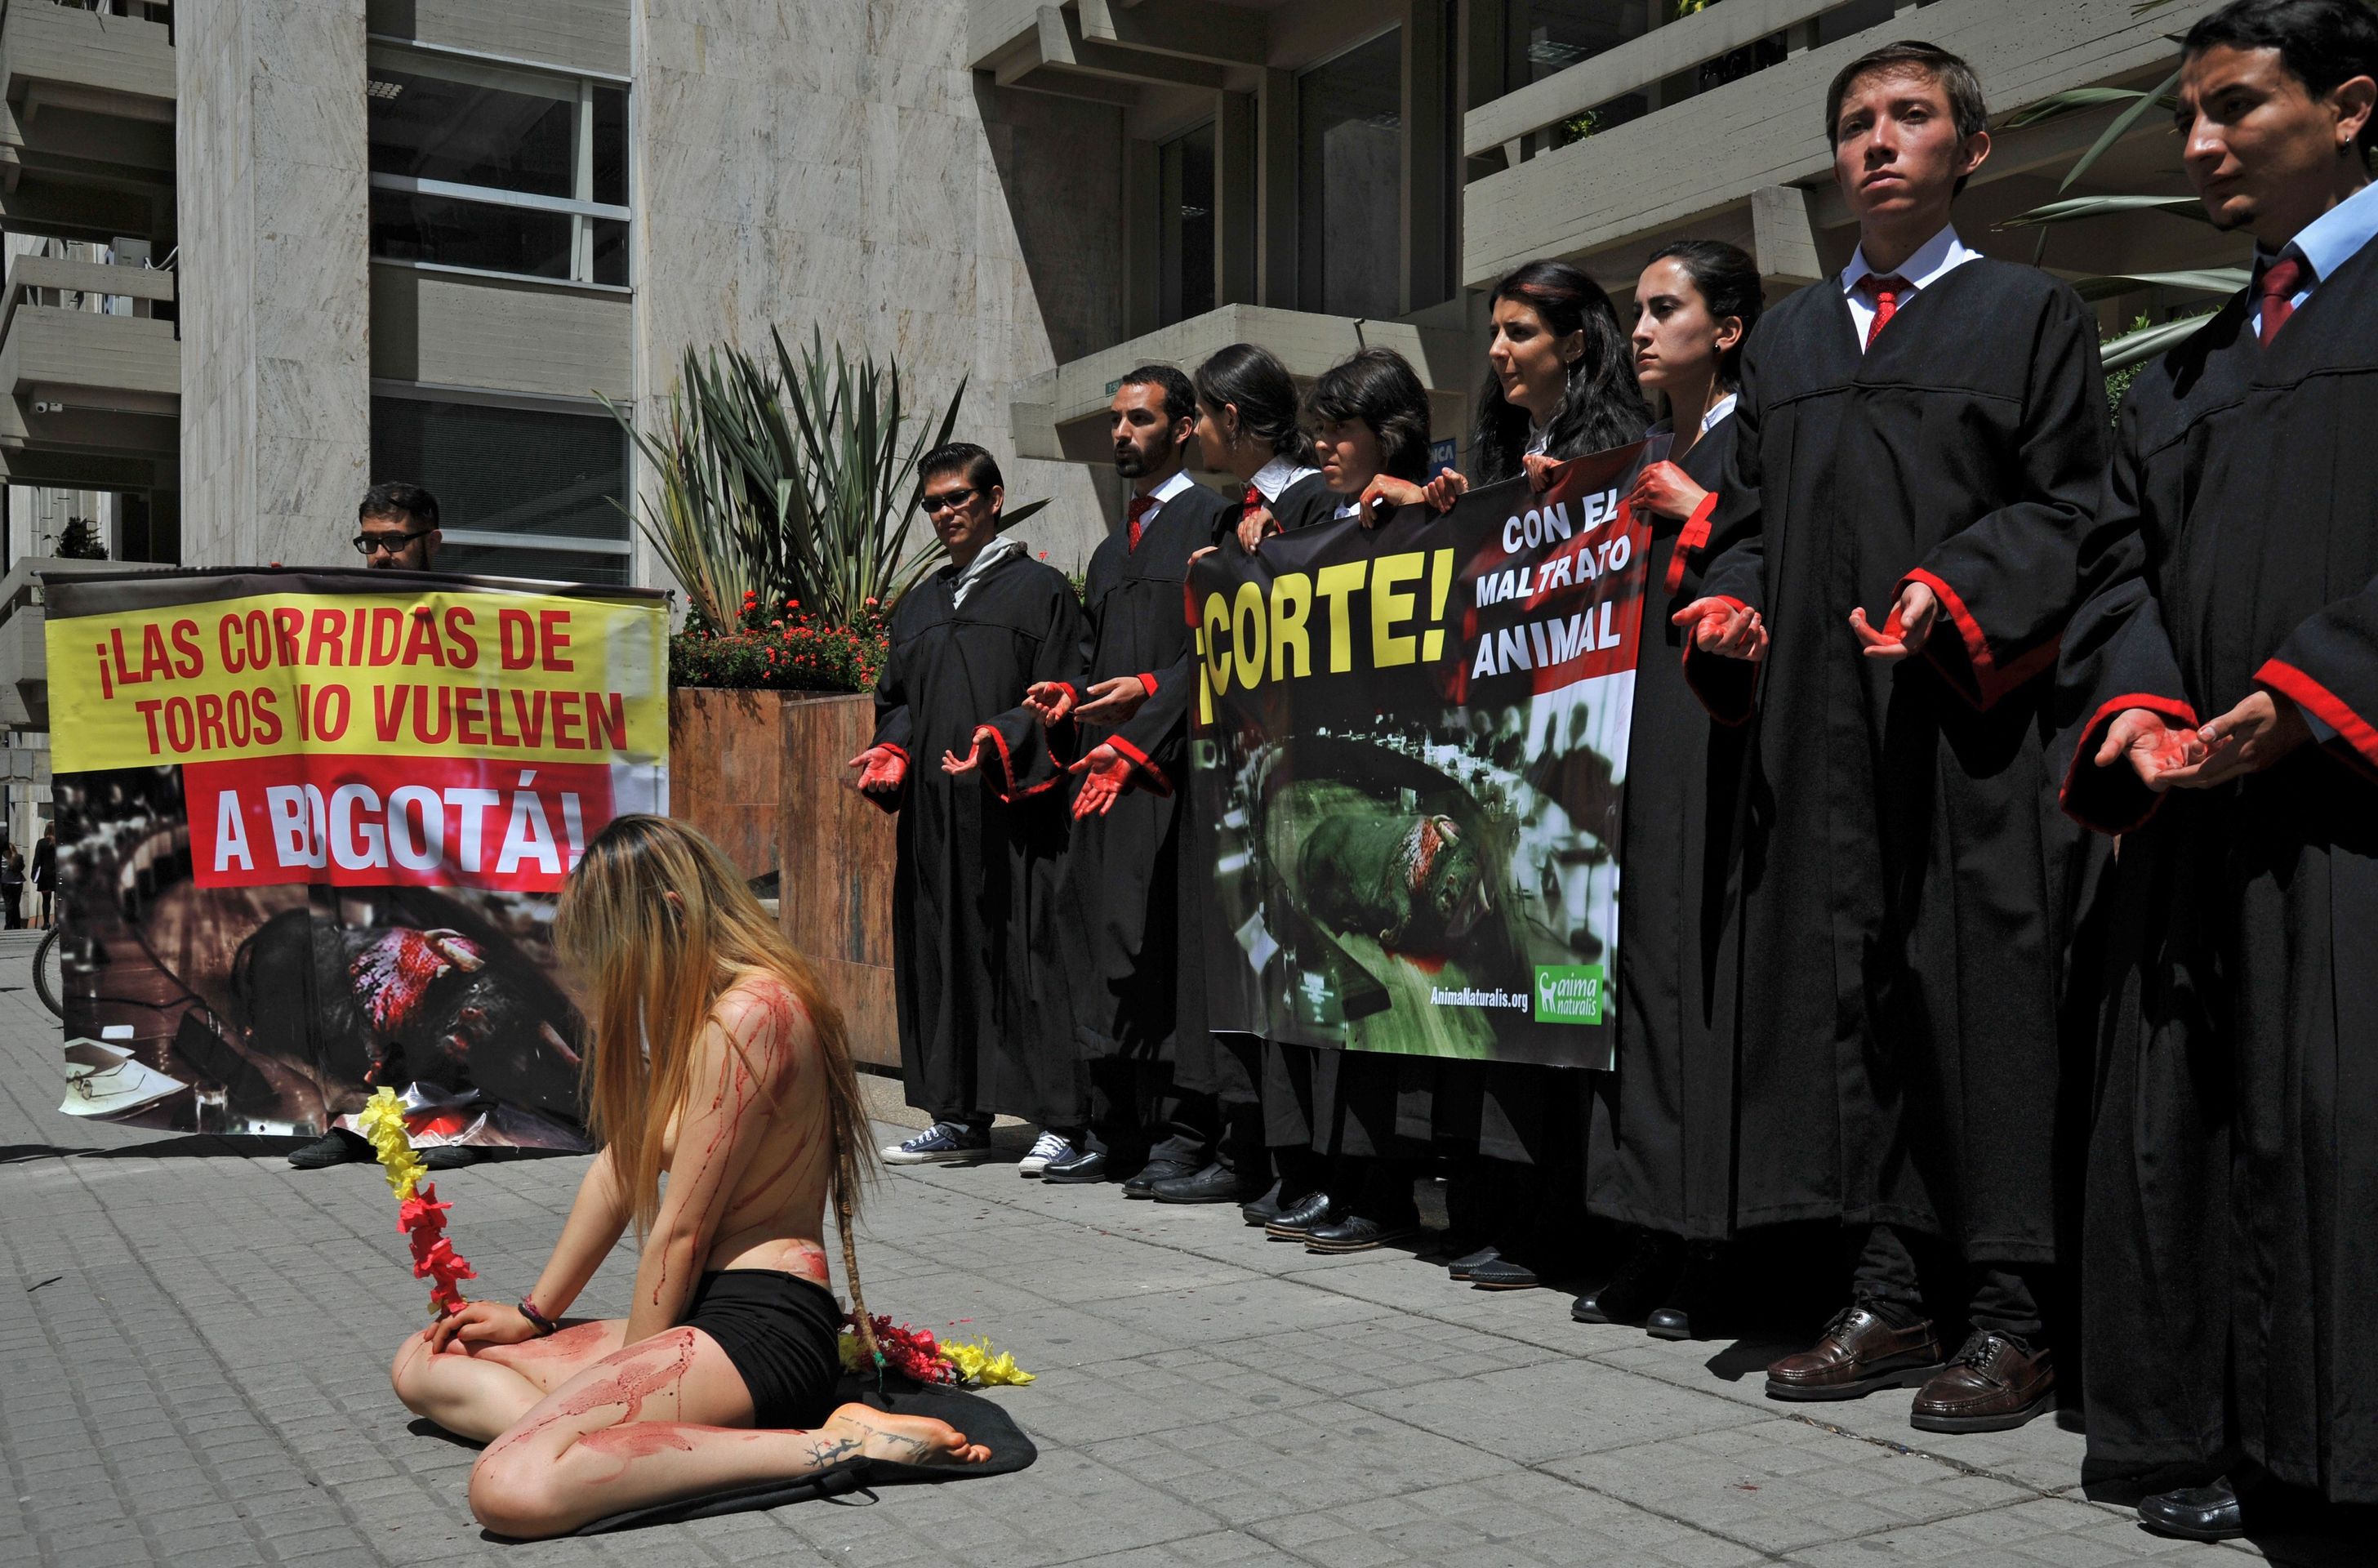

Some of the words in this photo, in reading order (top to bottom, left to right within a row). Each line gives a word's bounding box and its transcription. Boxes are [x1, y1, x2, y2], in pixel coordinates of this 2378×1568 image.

[1502, 502, 1571, 554] CON
[1583, 488, 1619, 534] EL
[1476, 534, 1631, 608] MALTRATO
[96, 618, 204, 700] ¡LAS
[218, 606, 479, 674] CORRIDAS
[498, 608, 574, 672] DE
[1196, 548, 1454, 726] ¡CORTE!
[1471, 600, 1621, 679] ANIMAL
[135, 686, 283, 755] TOROS
[372, 684, 628, 751] VUELVEN
[214, 790, 255, 872] A
[265, 769, 586, 875] BOGOTÁ!
[1430, 986, 1528, 1013] AnimaNaturalis.org
[1556, 972, 1597, 997] anima
[1556, 997, 1597, 1017] naturalis
